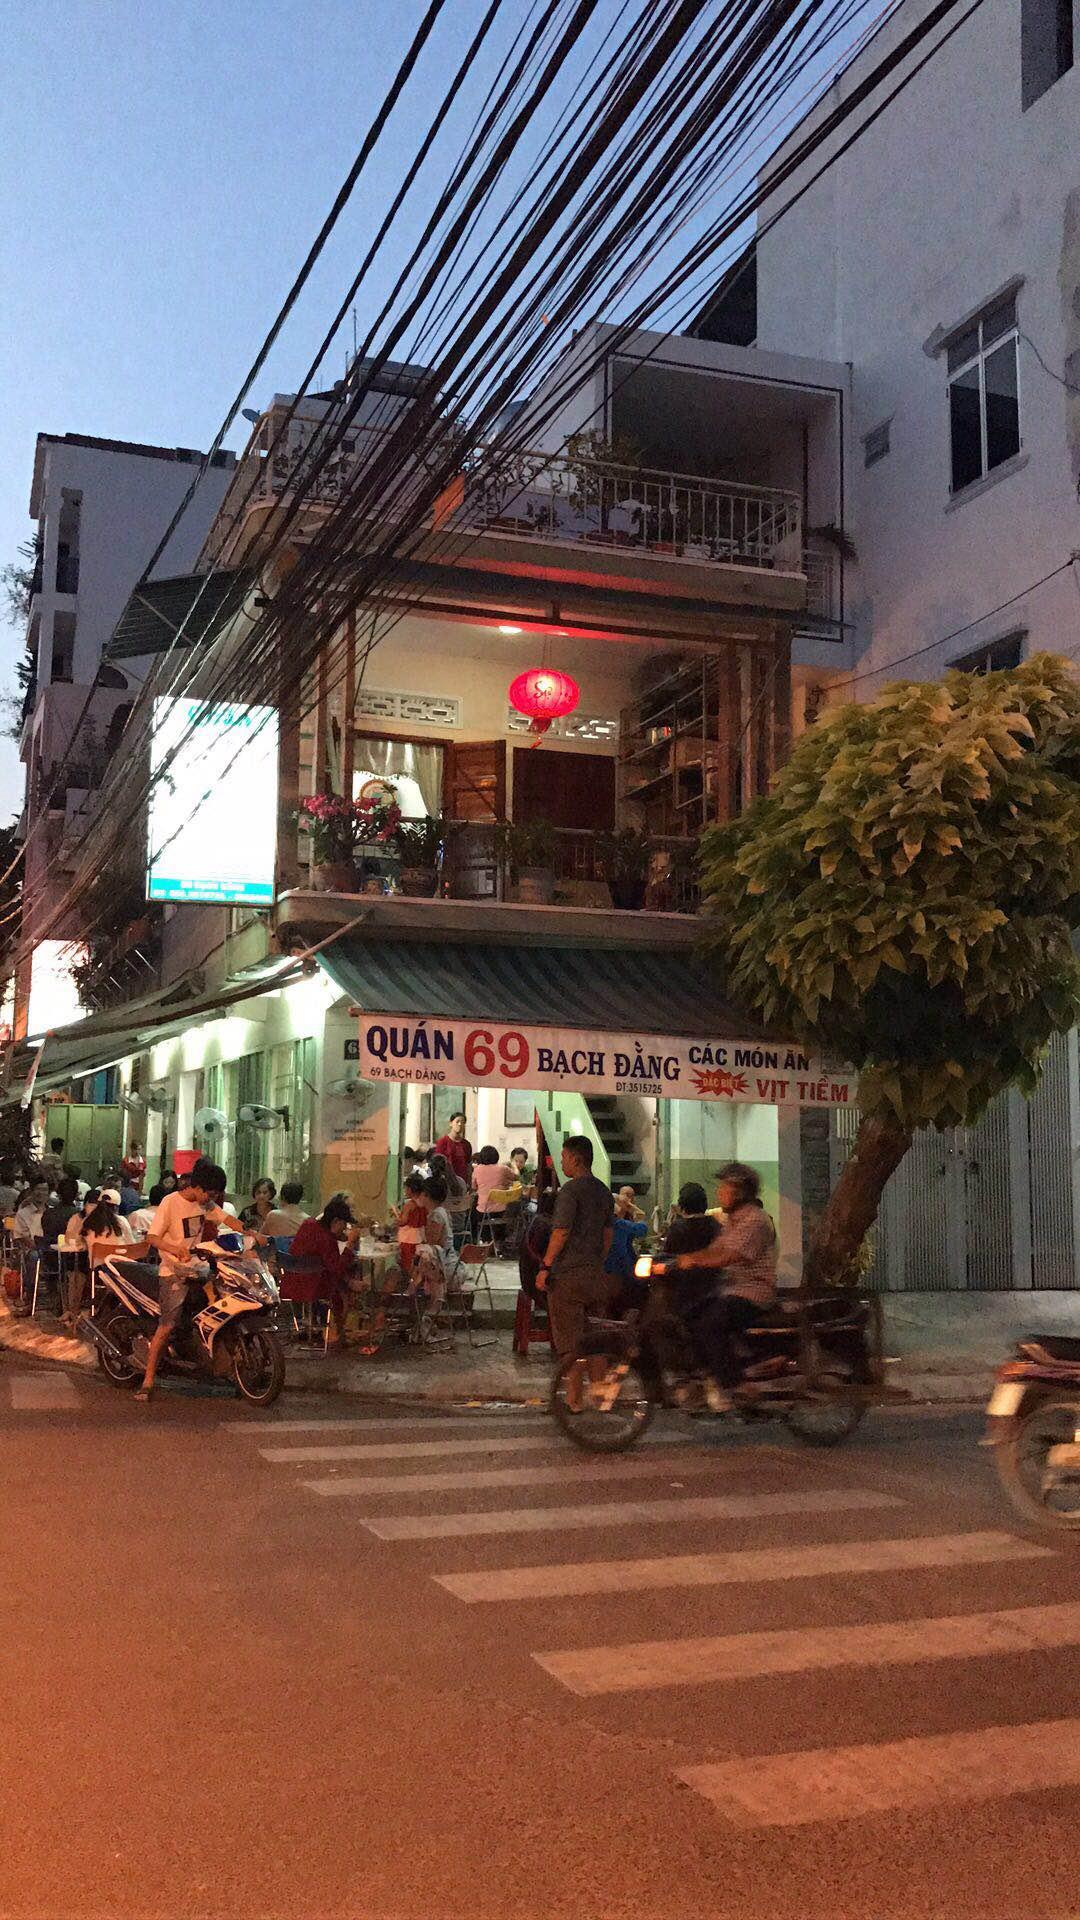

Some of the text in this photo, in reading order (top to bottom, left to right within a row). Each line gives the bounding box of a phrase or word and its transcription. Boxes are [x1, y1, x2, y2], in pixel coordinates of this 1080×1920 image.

[366, 1021, 681, 1081] QUÁN 69 BẠCH ĐẰNG
[688, 1042, 810, 1071] CÁC MÓN ĂN
[370, 1066, 382, 1077] 69
[756, 1075, 849, 1103] VỊT TIỀM
